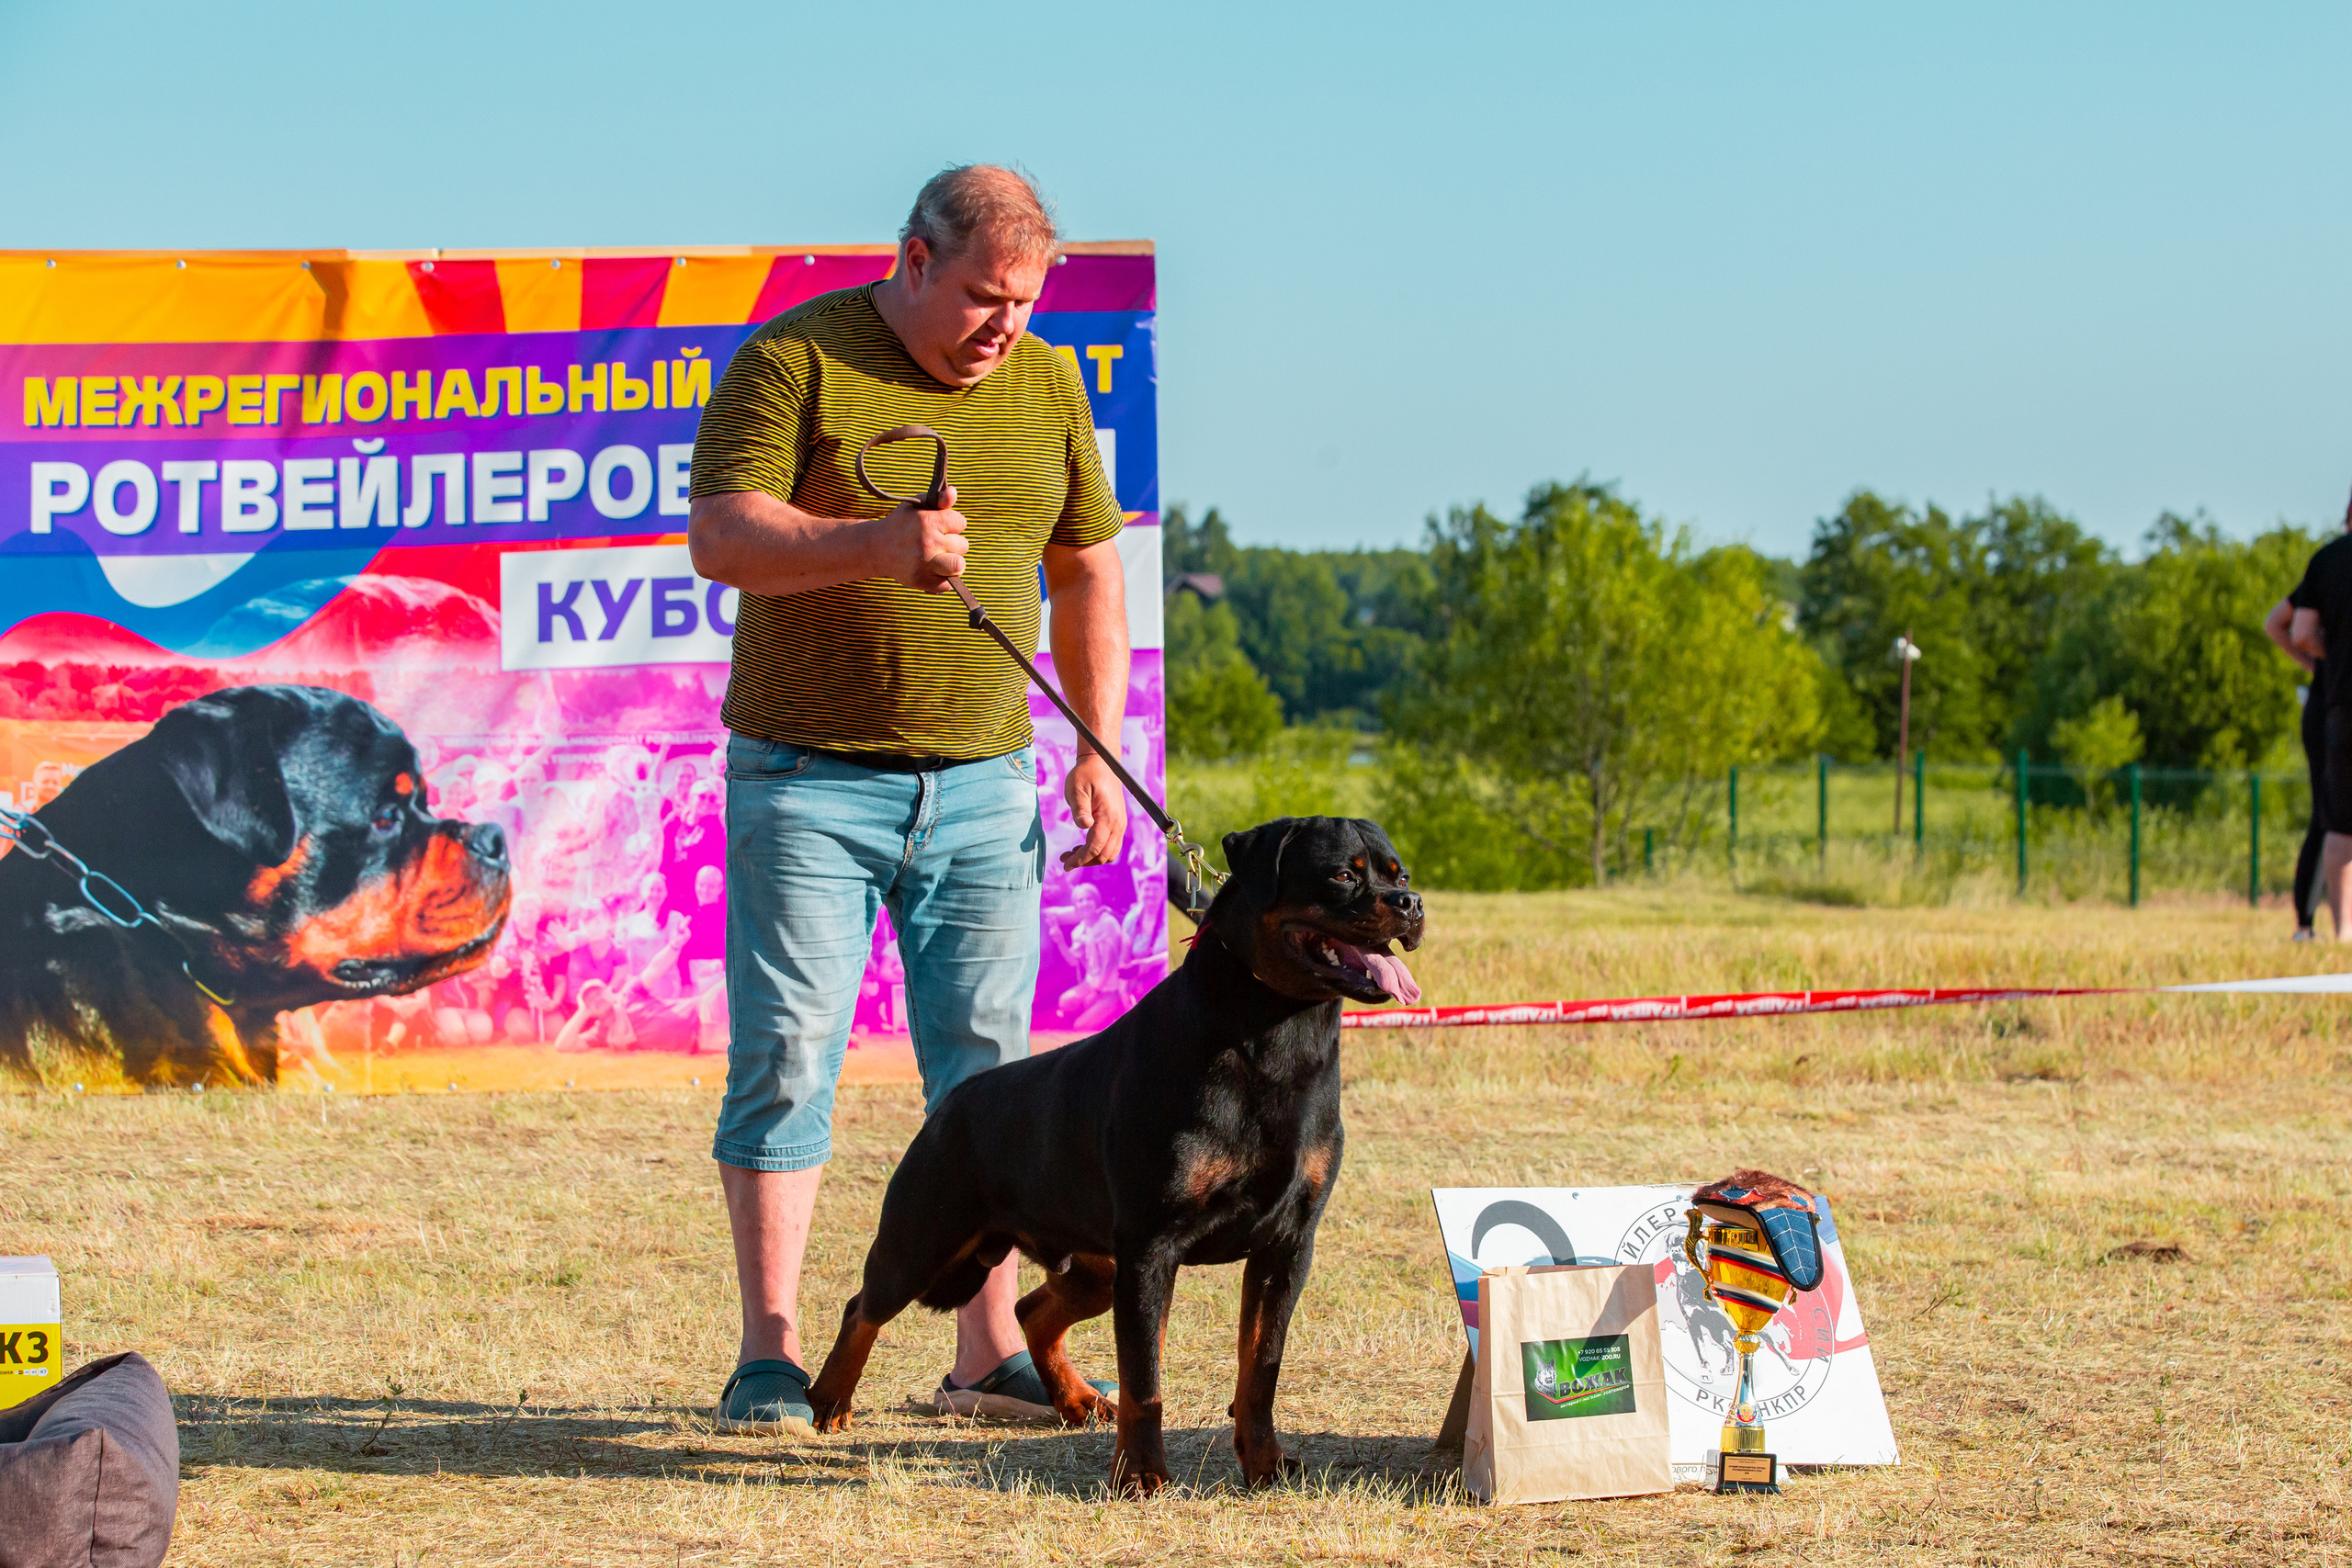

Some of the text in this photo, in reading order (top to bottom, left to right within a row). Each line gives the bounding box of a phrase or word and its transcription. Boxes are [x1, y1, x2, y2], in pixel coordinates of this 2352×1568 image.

[23, 346, 711, 427] МЕЖРЕГИОНАЛЬНЫЙ
[1559, 1367, 1629, 1397] ВОЖАК
[1695, 1385, 1806, 1417] РК НКПР
